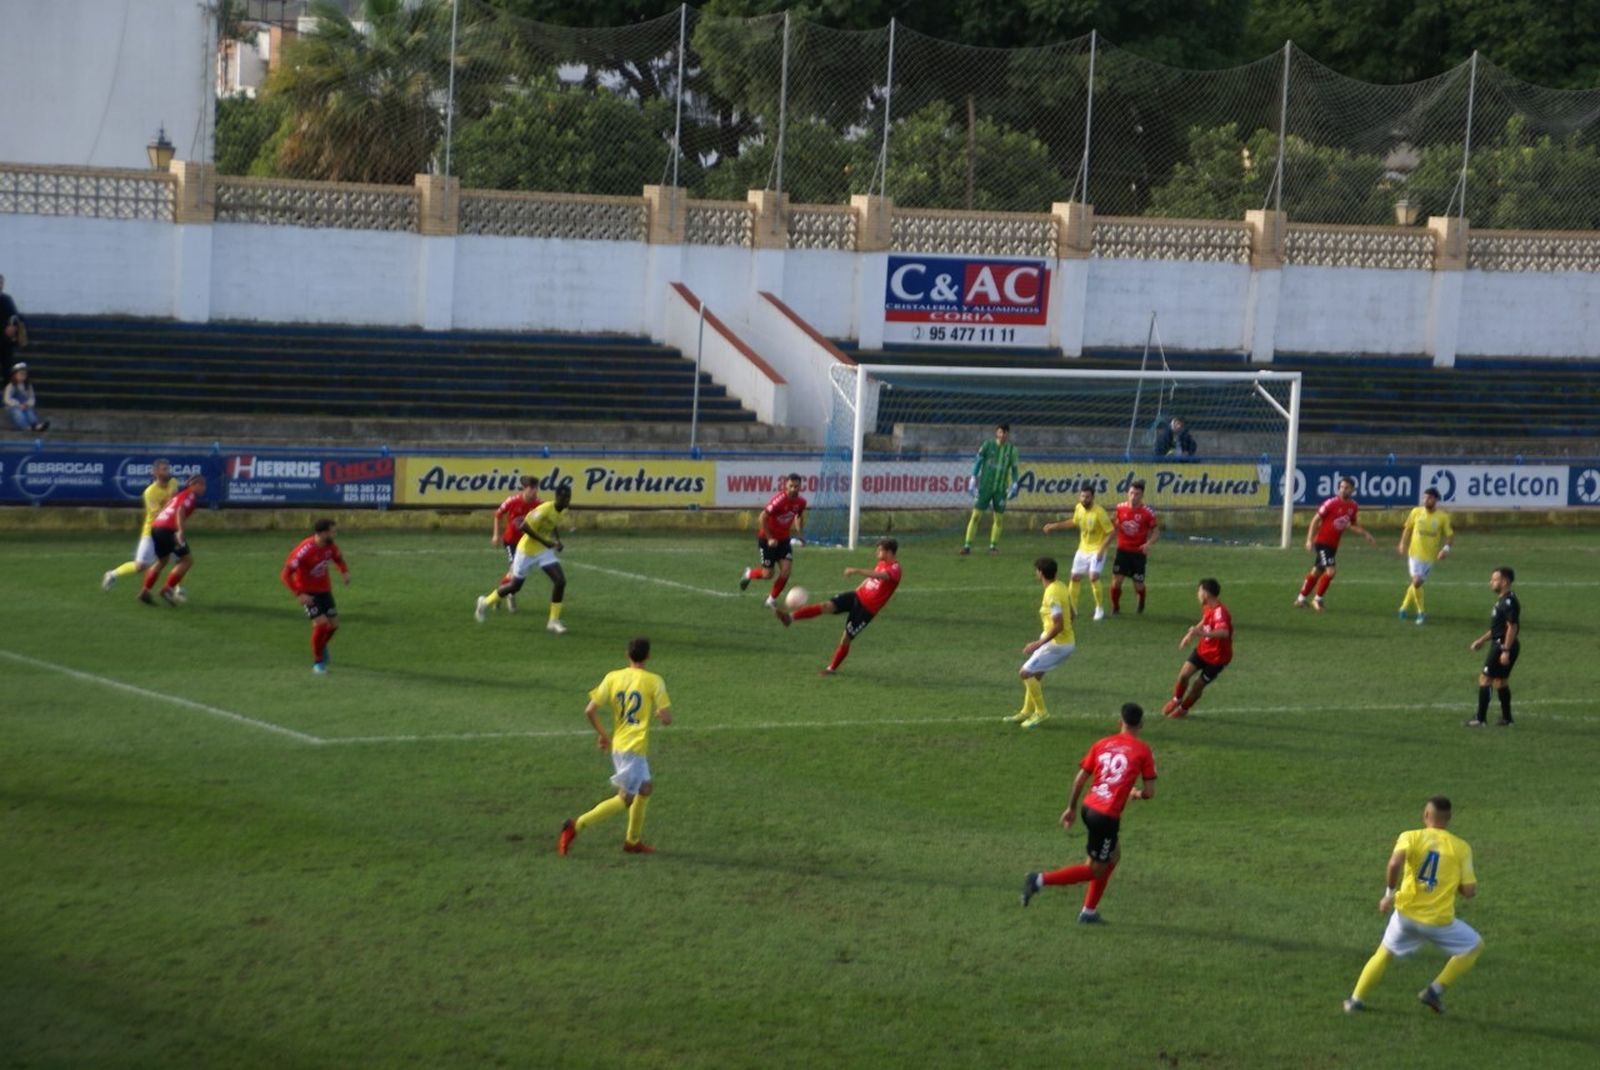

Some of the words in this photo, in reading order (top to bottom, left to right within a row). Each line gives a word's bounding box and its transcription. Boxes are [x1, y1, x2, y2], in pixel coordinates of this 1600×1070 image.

[929, 311, 995, 322] CORIA
[973, 305, 1040, 314] ALUMINIOS
[929, 326, 946, 341] 95
[950, 327, 975, 341] 477
[980, 328, 995, 342] 11
[1001, 328, 1015, 342] 11
[27, 462, 104, 474] BERROCAR
[233, 455, 321, 480] HIERROS
[584, 467, 705, 493] Pinturas
[1156, 471, 1260, 495] Pinturas
[1467, 472, 1559, 497] atelcon
[616, 690, 642, 724] 12
[1097, 752, 1128, 784] 19
[1417, 850, 1440, 887] 4
